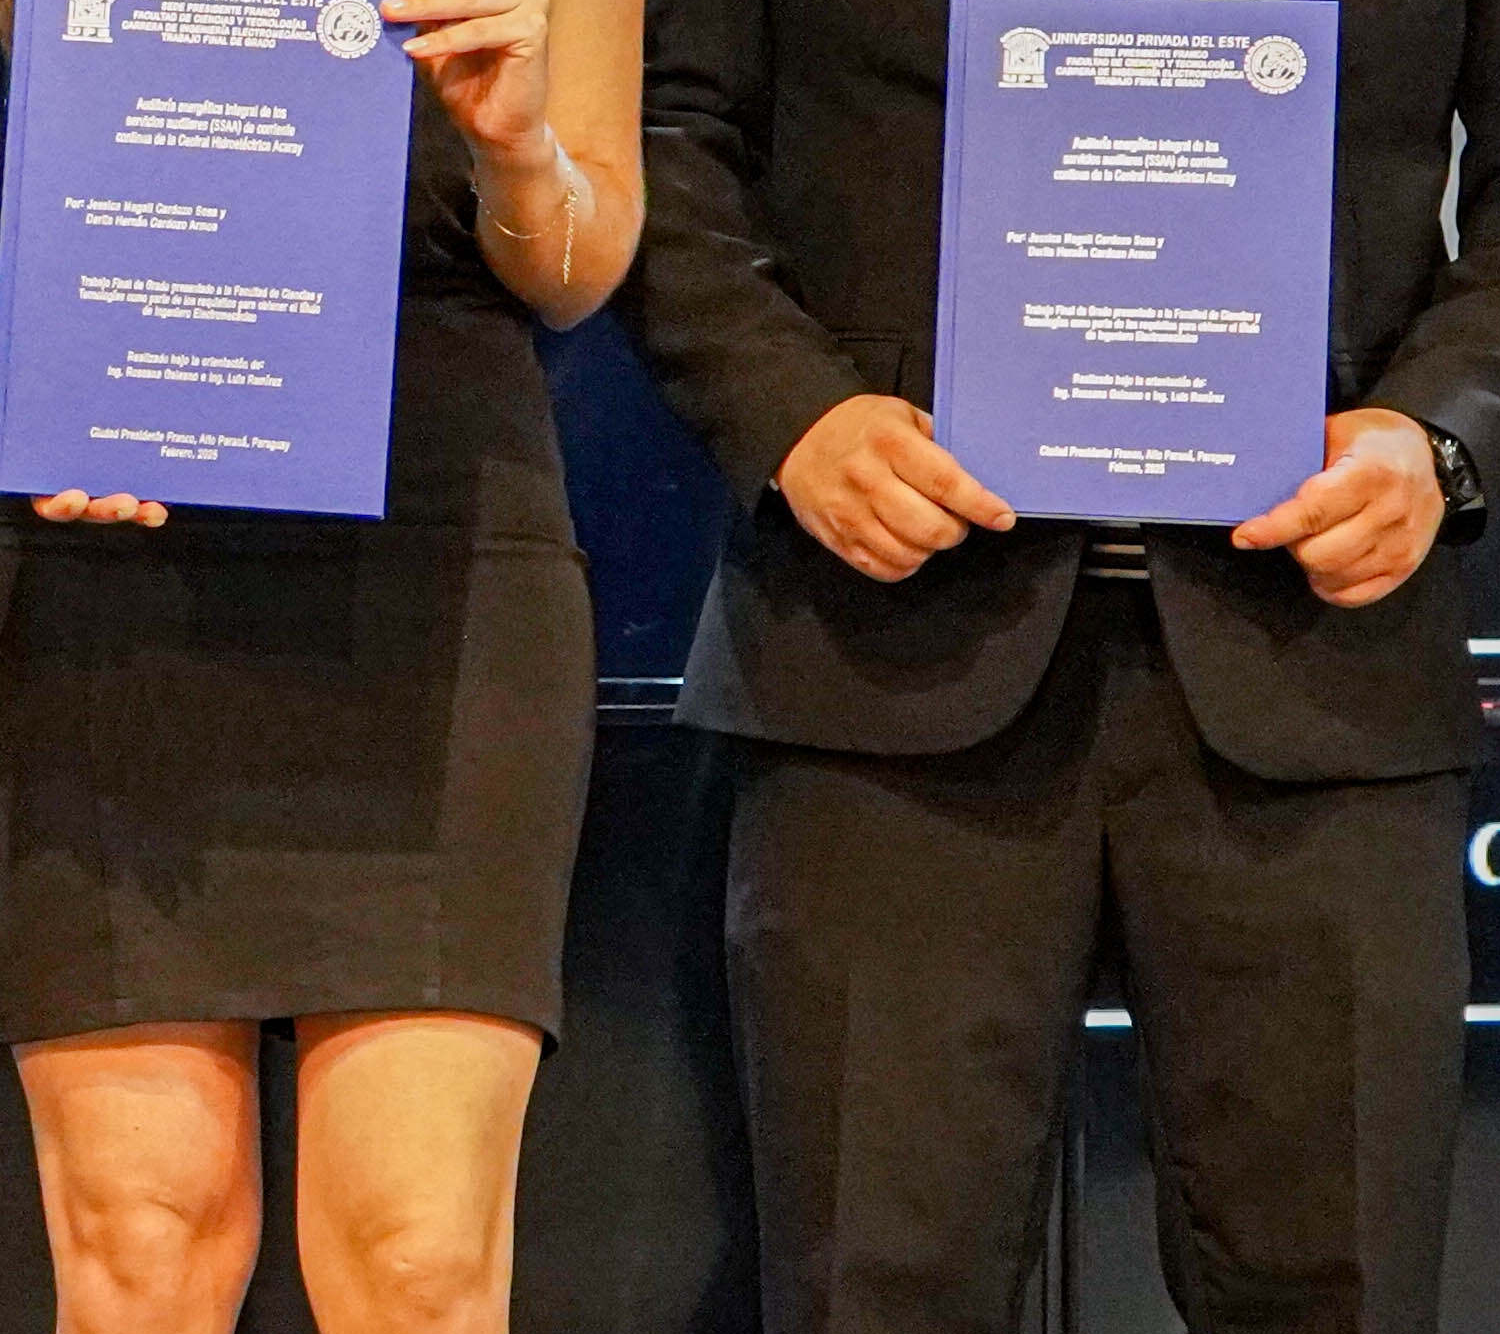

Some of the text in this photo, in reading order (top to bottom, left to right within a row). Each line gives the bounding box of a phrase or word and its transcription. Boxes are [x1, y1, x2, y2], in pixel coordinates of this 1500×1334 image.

[1052, 32, 1250, 49] UNIVERSIDAD PRIVADA DEL ESTE
